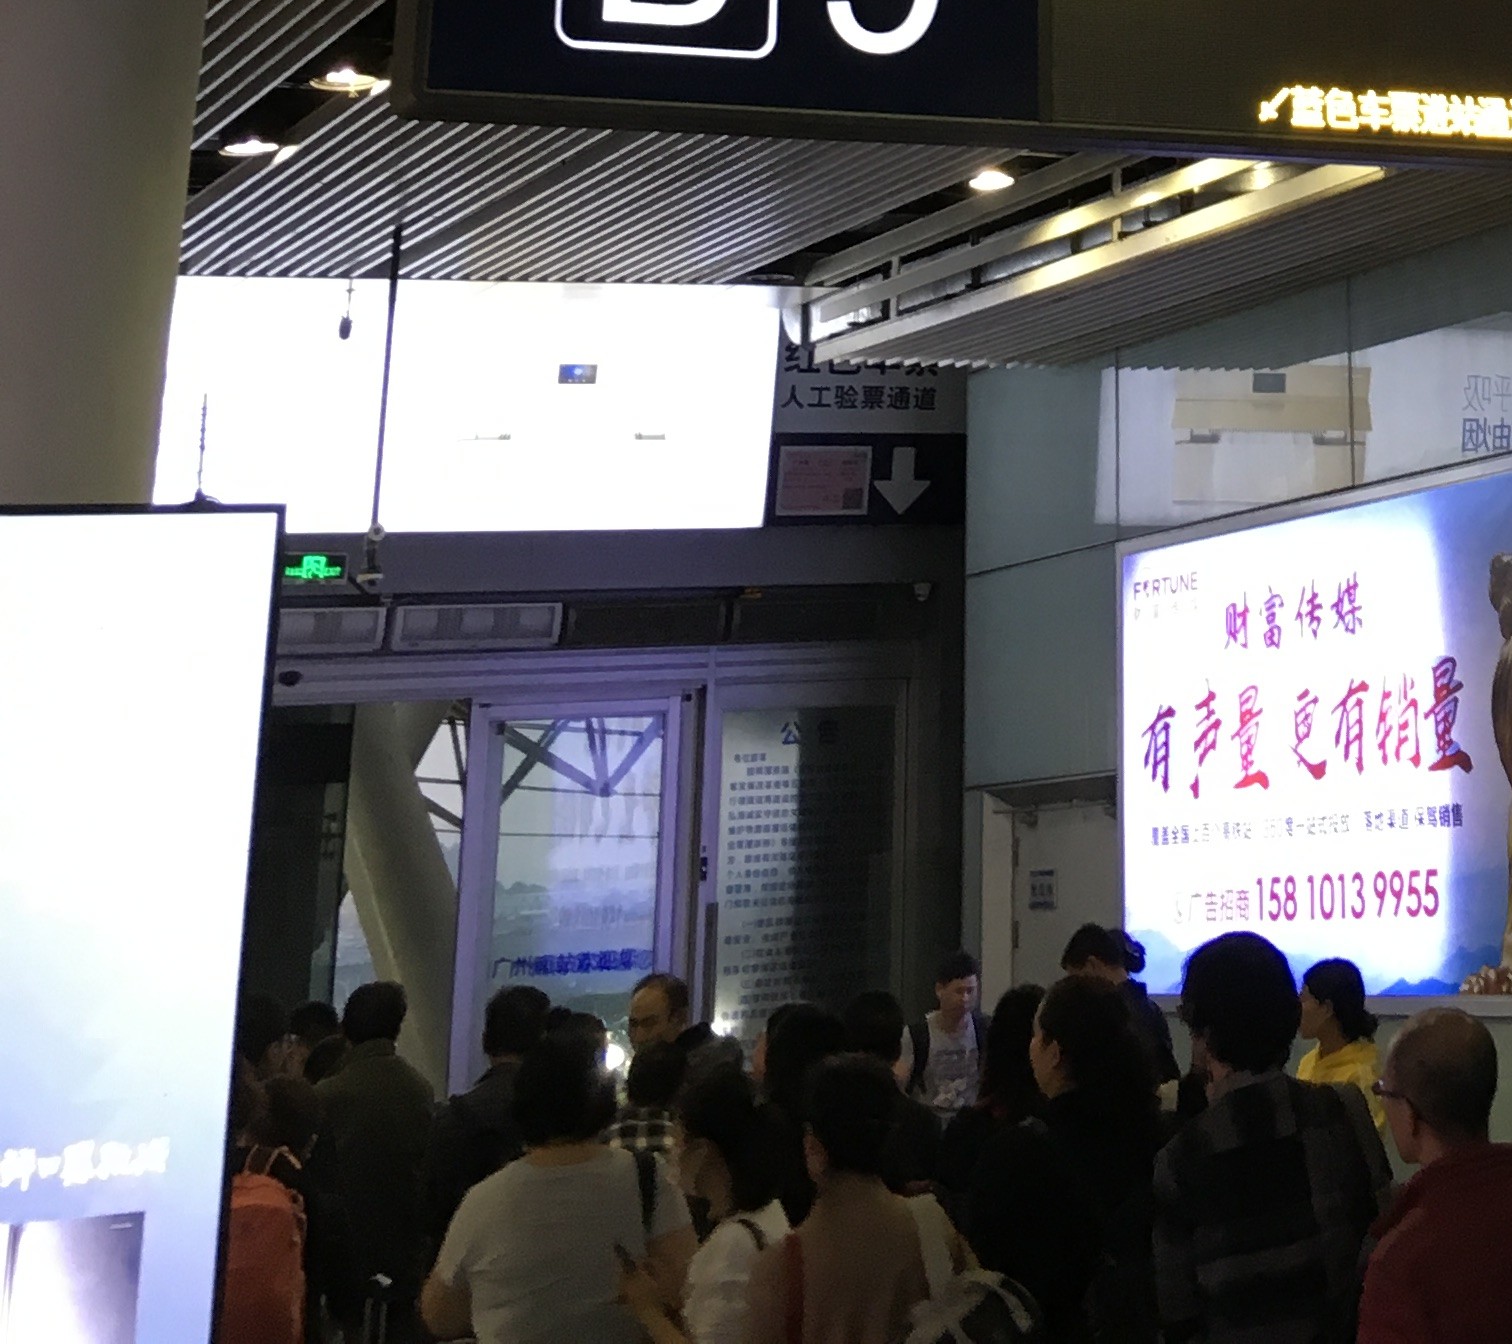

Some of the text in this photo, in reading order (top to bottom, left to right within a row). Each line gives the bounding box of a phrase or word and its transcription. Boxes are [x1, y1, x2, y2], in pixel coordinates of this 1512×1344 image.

[781, 385, 938, 411] 人工验票通道
[1224, 572, 1364, 650] 财富传媒
[1256, 875, 1298, 922] 158
[1306, 870, 1366, 921] 1013
[1372, 868, 1441, 918] 9955
